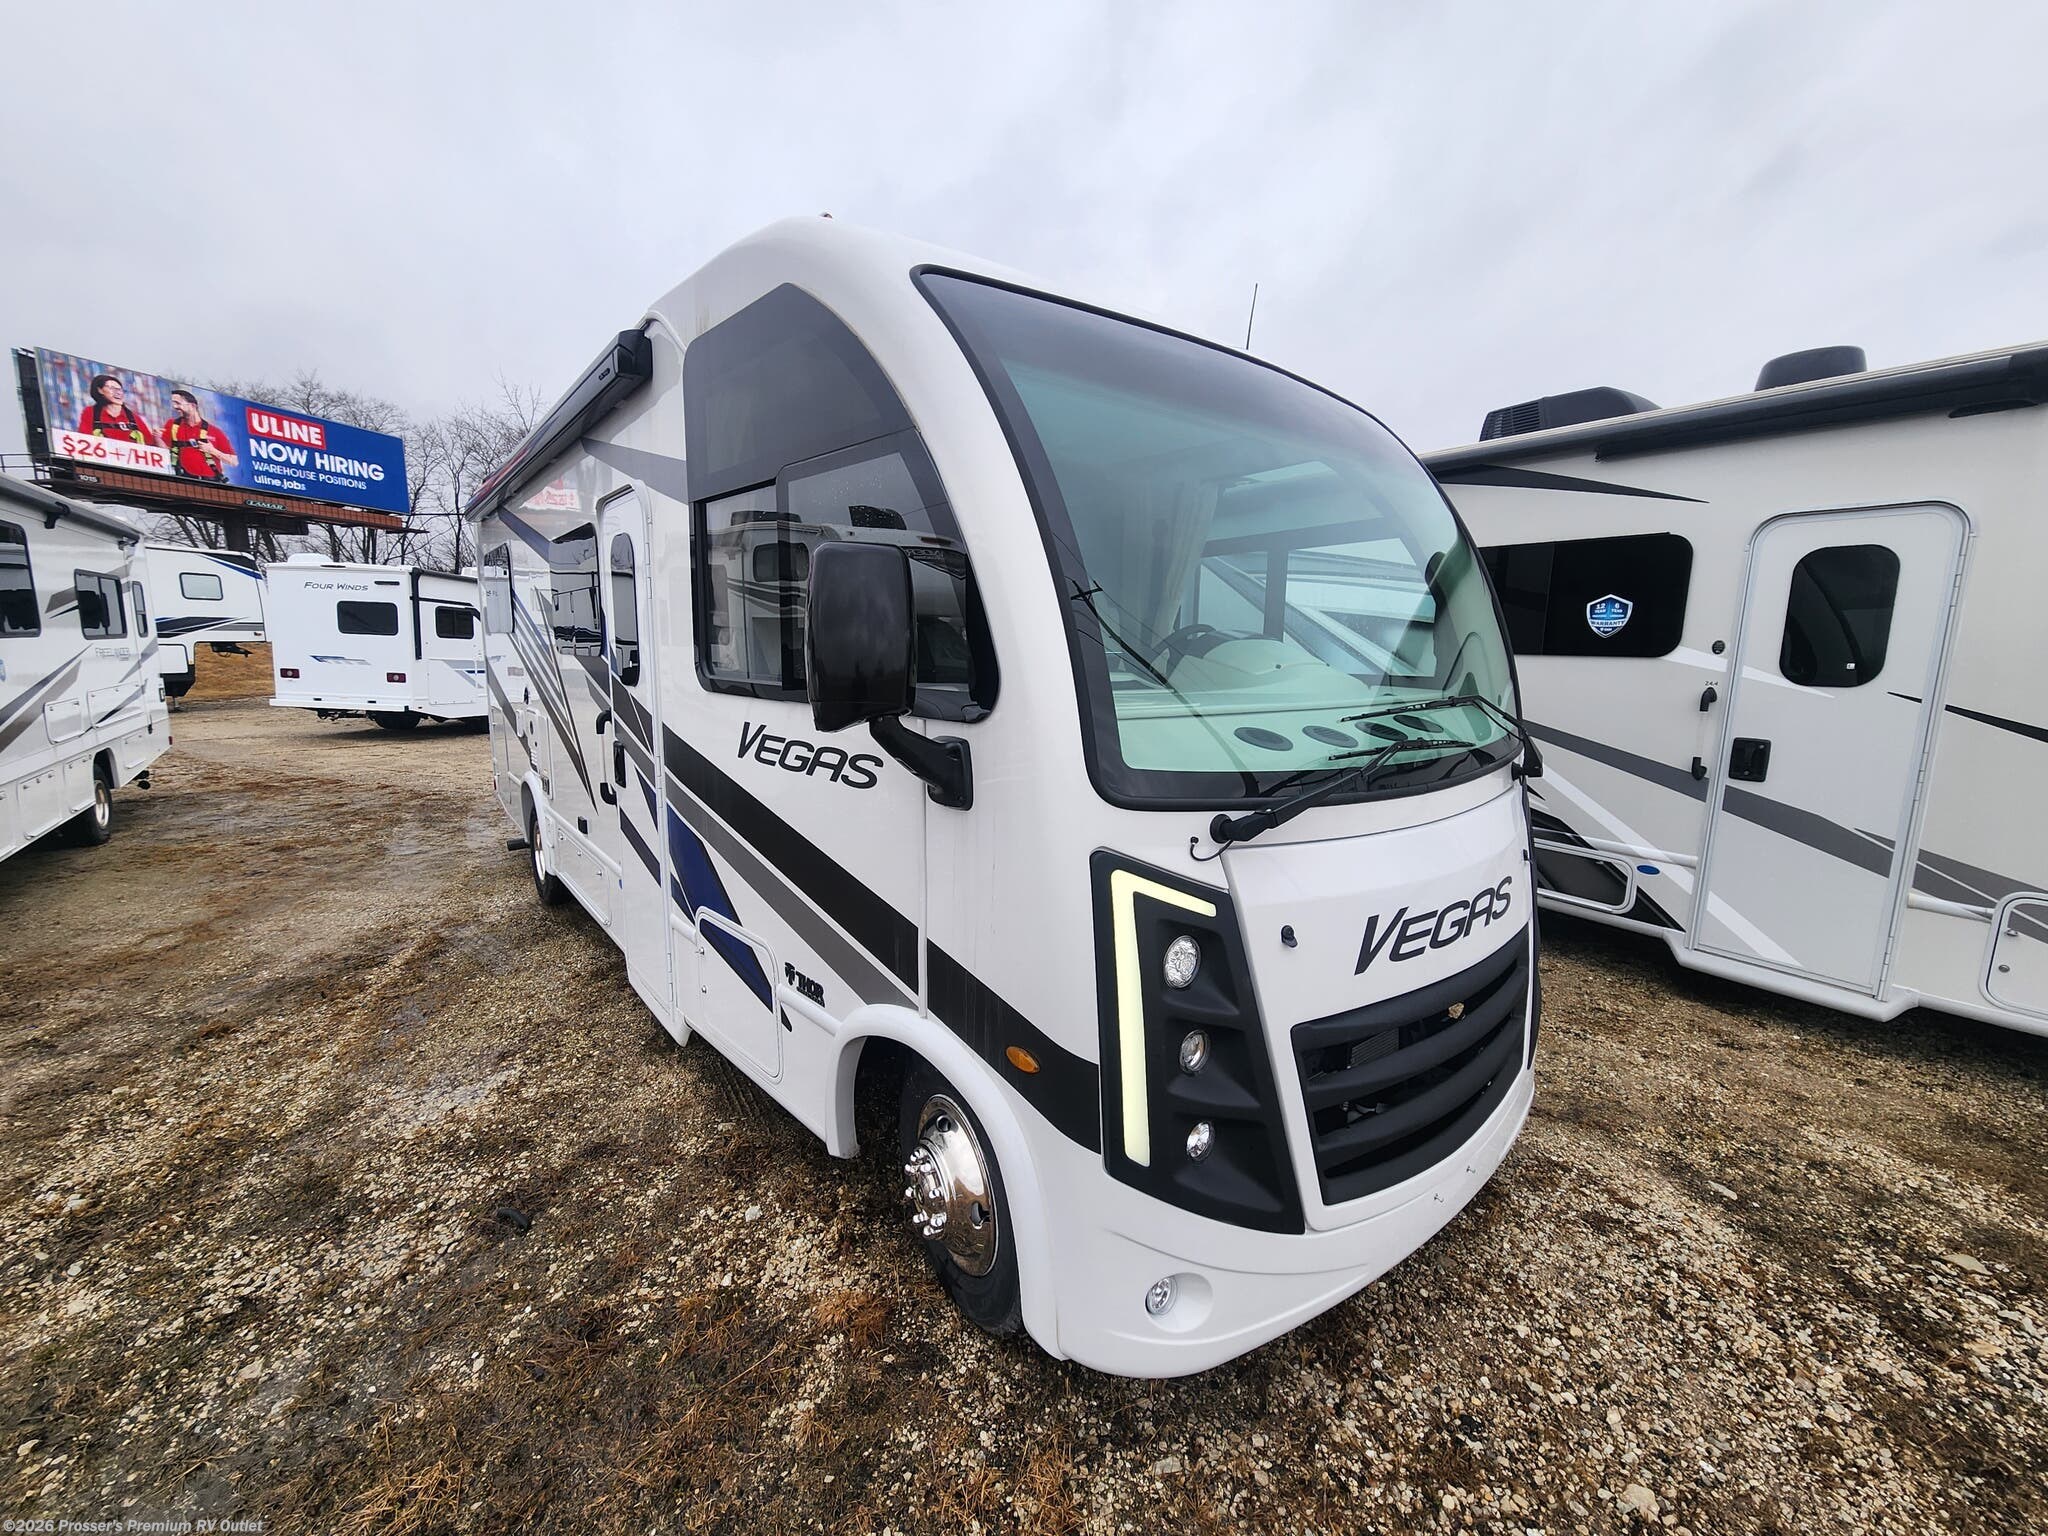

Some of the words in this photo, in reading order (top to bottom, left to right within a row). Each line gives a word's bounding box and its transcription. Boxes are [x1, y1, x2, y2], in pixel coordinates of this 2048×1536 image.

[251, 412, 323, 446] ULINE
[62, 434, 164, 468] $26+/HR
[250, 438, 308, 467] NOW
[314, 452, 385, 482] HIRING
[252, 460, 317, 481] WAREHOUSE
[319, 474, 367, 490] POSITIONS
[254, 474, 307, 491] uline.jobs
[304, 581, 334, 590] FOUR
[337, 583, 369, 591] WINDS
[737, 721, 884, 789] VEGAS
[1354, 875, 1513, 976] VEGAS
